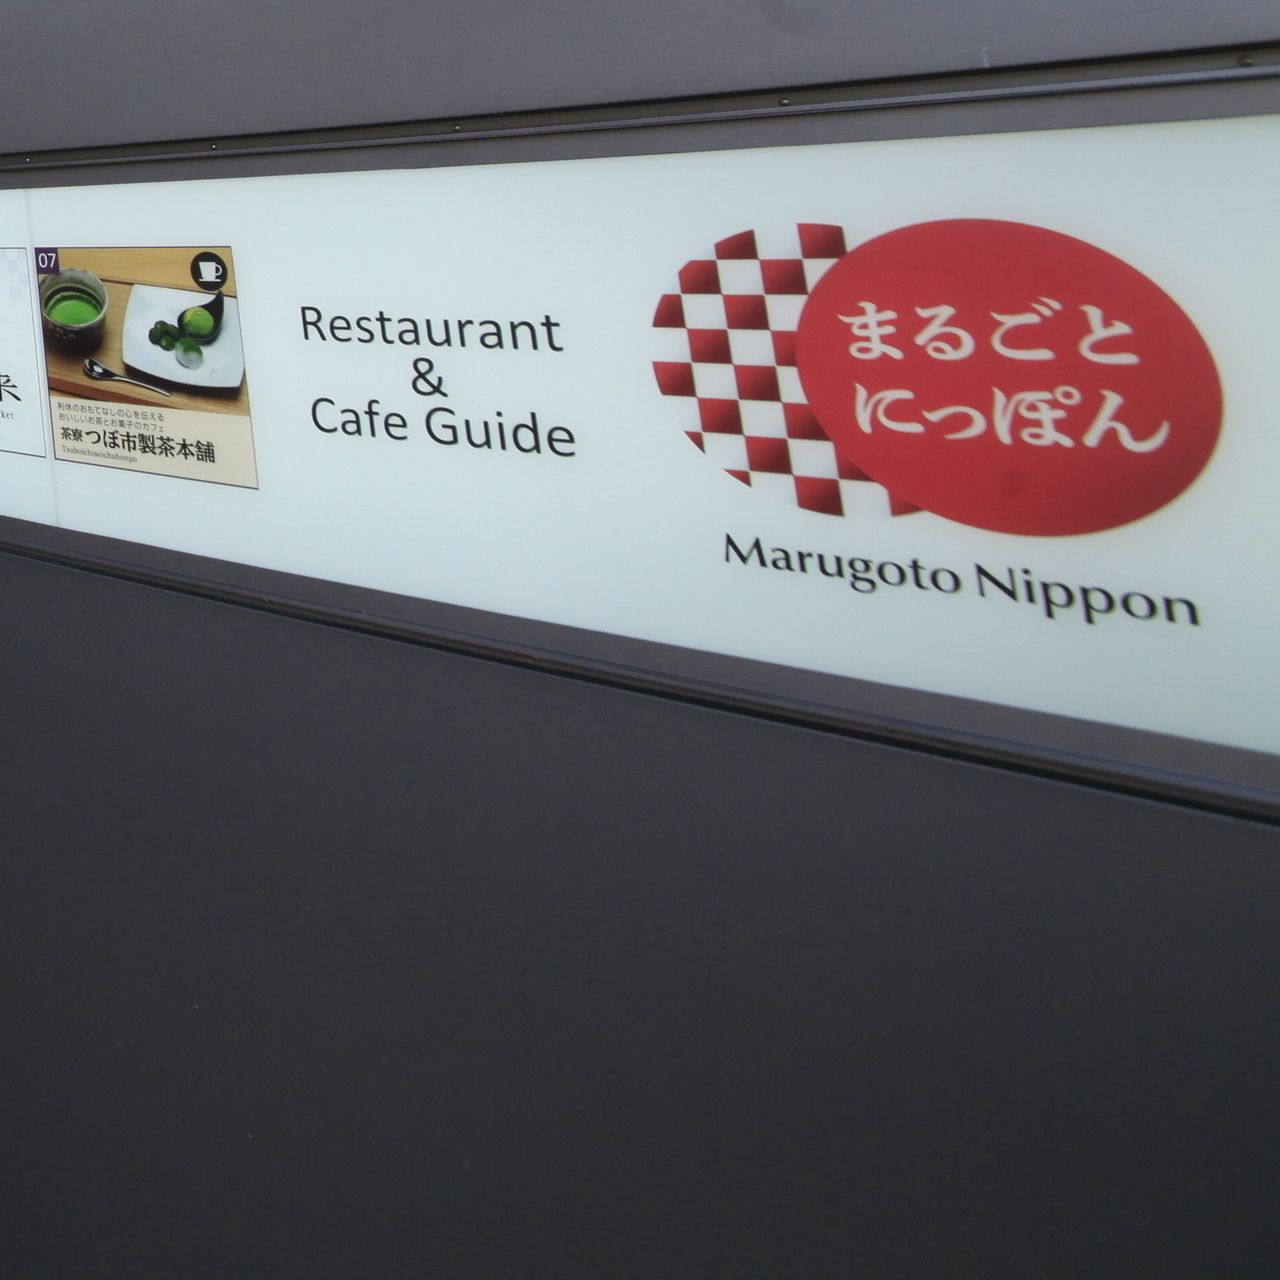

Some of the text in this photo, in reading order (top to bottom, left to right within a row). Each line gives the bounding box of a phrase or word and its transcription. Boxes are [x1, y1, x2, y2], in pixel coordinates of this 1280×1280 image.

[38, 253, 56, 268] 07
[299, 305, 565, 354] Restaurant
[837, 296, 1142, 366] まるごと
[410, 357, 448, 398] &
[57, 402, 165, 422] 利休のおもてなしの心を伝える
[58, 413, 164, 432] おいしいお茶とお菓子のカフェ
[310, 397, 578, 458] Cafe Guide
[853, 380, 1172, 455] にっぽん
[724, 532, 1202, 627] Marugoto Nippon
